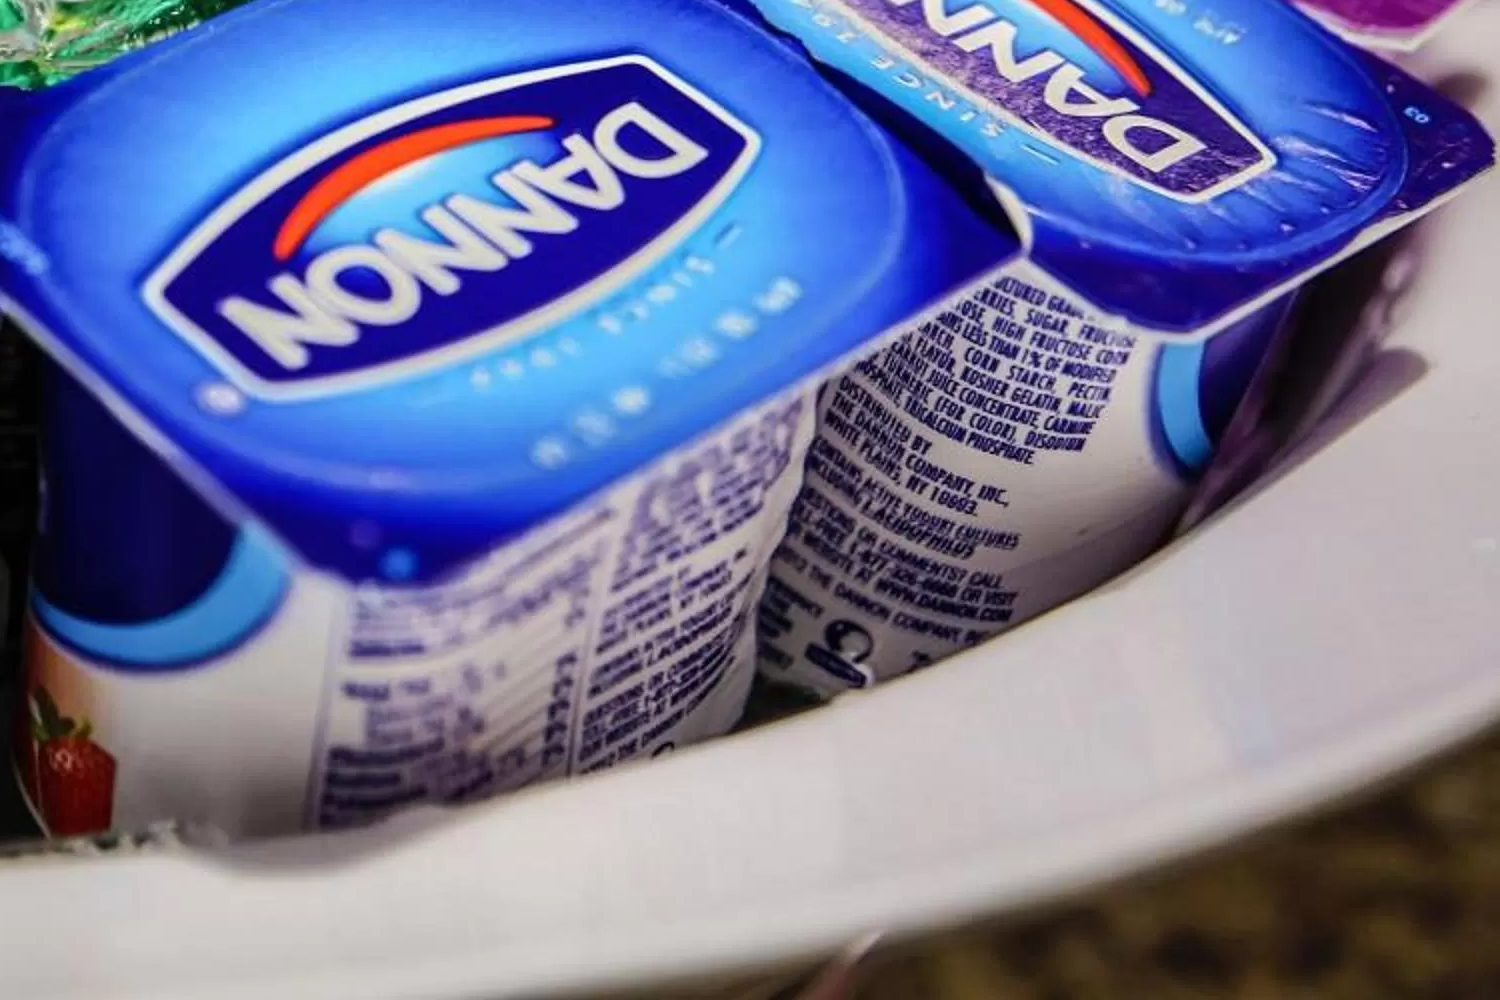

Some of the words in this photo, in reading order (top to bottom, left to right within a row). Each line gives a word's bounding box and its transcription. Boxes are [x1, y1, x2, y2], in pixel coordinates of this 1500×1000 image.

[214, 100, 711, 371] DANNON
[917, 321, 956, 354] ARCH,
[963, 346, 1001, 374] CORN
[1005, 365, 1059, 394] STARCH,
[1066, 381, 1113, 402] PECTIN
[961, 322, 989, 347] LESS
[989, 335, 1023, 361] THAN
[1044, 356, 1063, 373] OF
[991, 315, 1027, 342] HIGH
[1029, 330, 1093, 361] FRUCTOSE
[1095, 348, 1131, 366] CORN
[839, 375, 912, 444] DISTRIBUTED
[910, 434, 933, 455] BY
[903, 395, 969, 444] TRICALCIUM
[926, 368, 961, 398] JUICE
[1043, 414, 1097, 435] CARMINE
[933, 393, 968, 422] (FOR
[1023, 430, 1088, 453] DISODIUM
[959, 365, 1011, 399] KOSHER
[1010, 386, 1063, 415] GELATIN,
[1065, 400, 1106, 419] MALIC
[824, 408, 861, 446] WHITE
[858, 439, 903, 485] PLAINS,
[905, 474, 929, 496] NY
[830, 390, 855, 418] THE
[852, 408, 907, 462] DANNON
[904, 453, 976, 499] COMPANY,
[856, 525, 880, 546] OR
[879, 537, 969, 584] COMMENTS?
[968, 570, 1005, 589] CALL
[901, 501, 957, 538] YOGURT
[954, 521, 1023, 551] CULTURES
